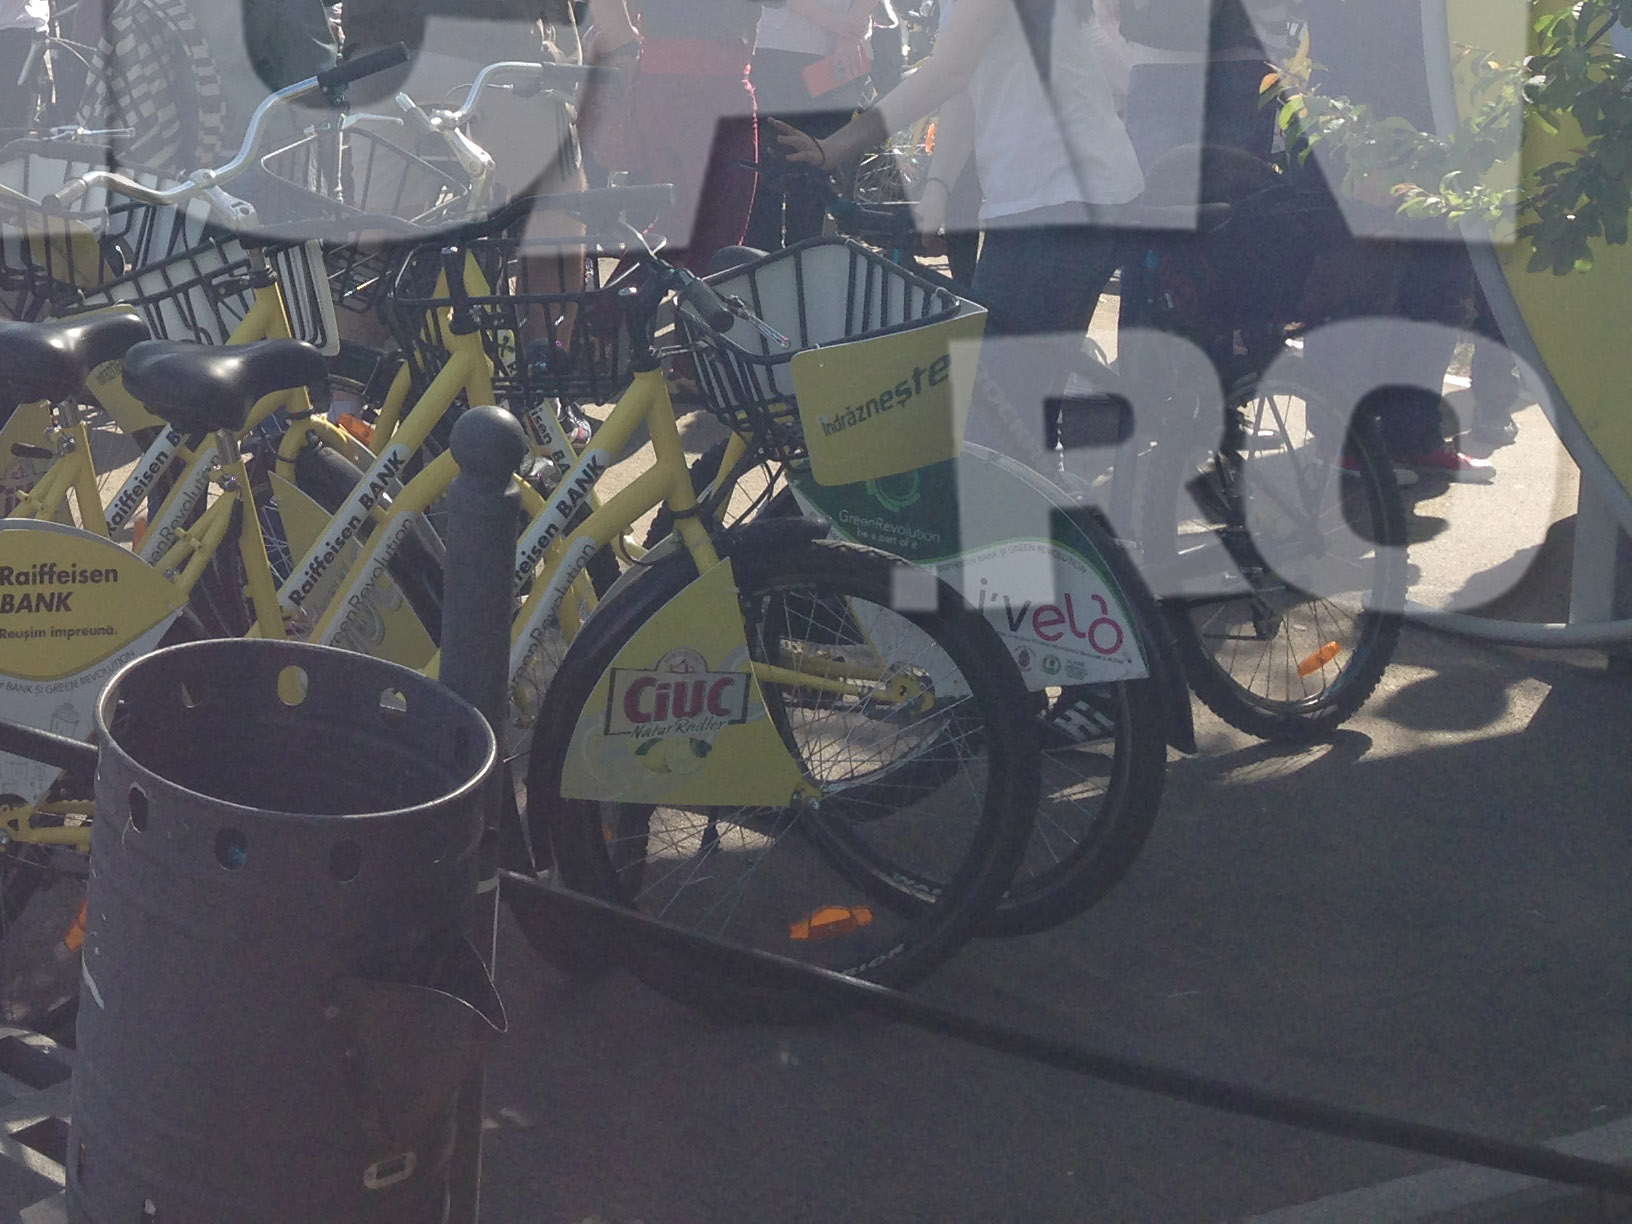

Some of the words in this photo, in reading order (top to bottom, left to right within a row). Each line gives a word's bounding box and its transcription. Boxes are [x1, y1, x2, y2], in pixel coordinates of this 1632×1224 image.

[555, 454, 606, 520] BANK
[287, 514, 362, 608] Raiffeisen
[358, 449, 406, 512] BANK
[838, 509, 942, 544] GreenRevolution
[0, 563, 119, 587] Raiffeisen
[0, 592, 74, 614] BANK
